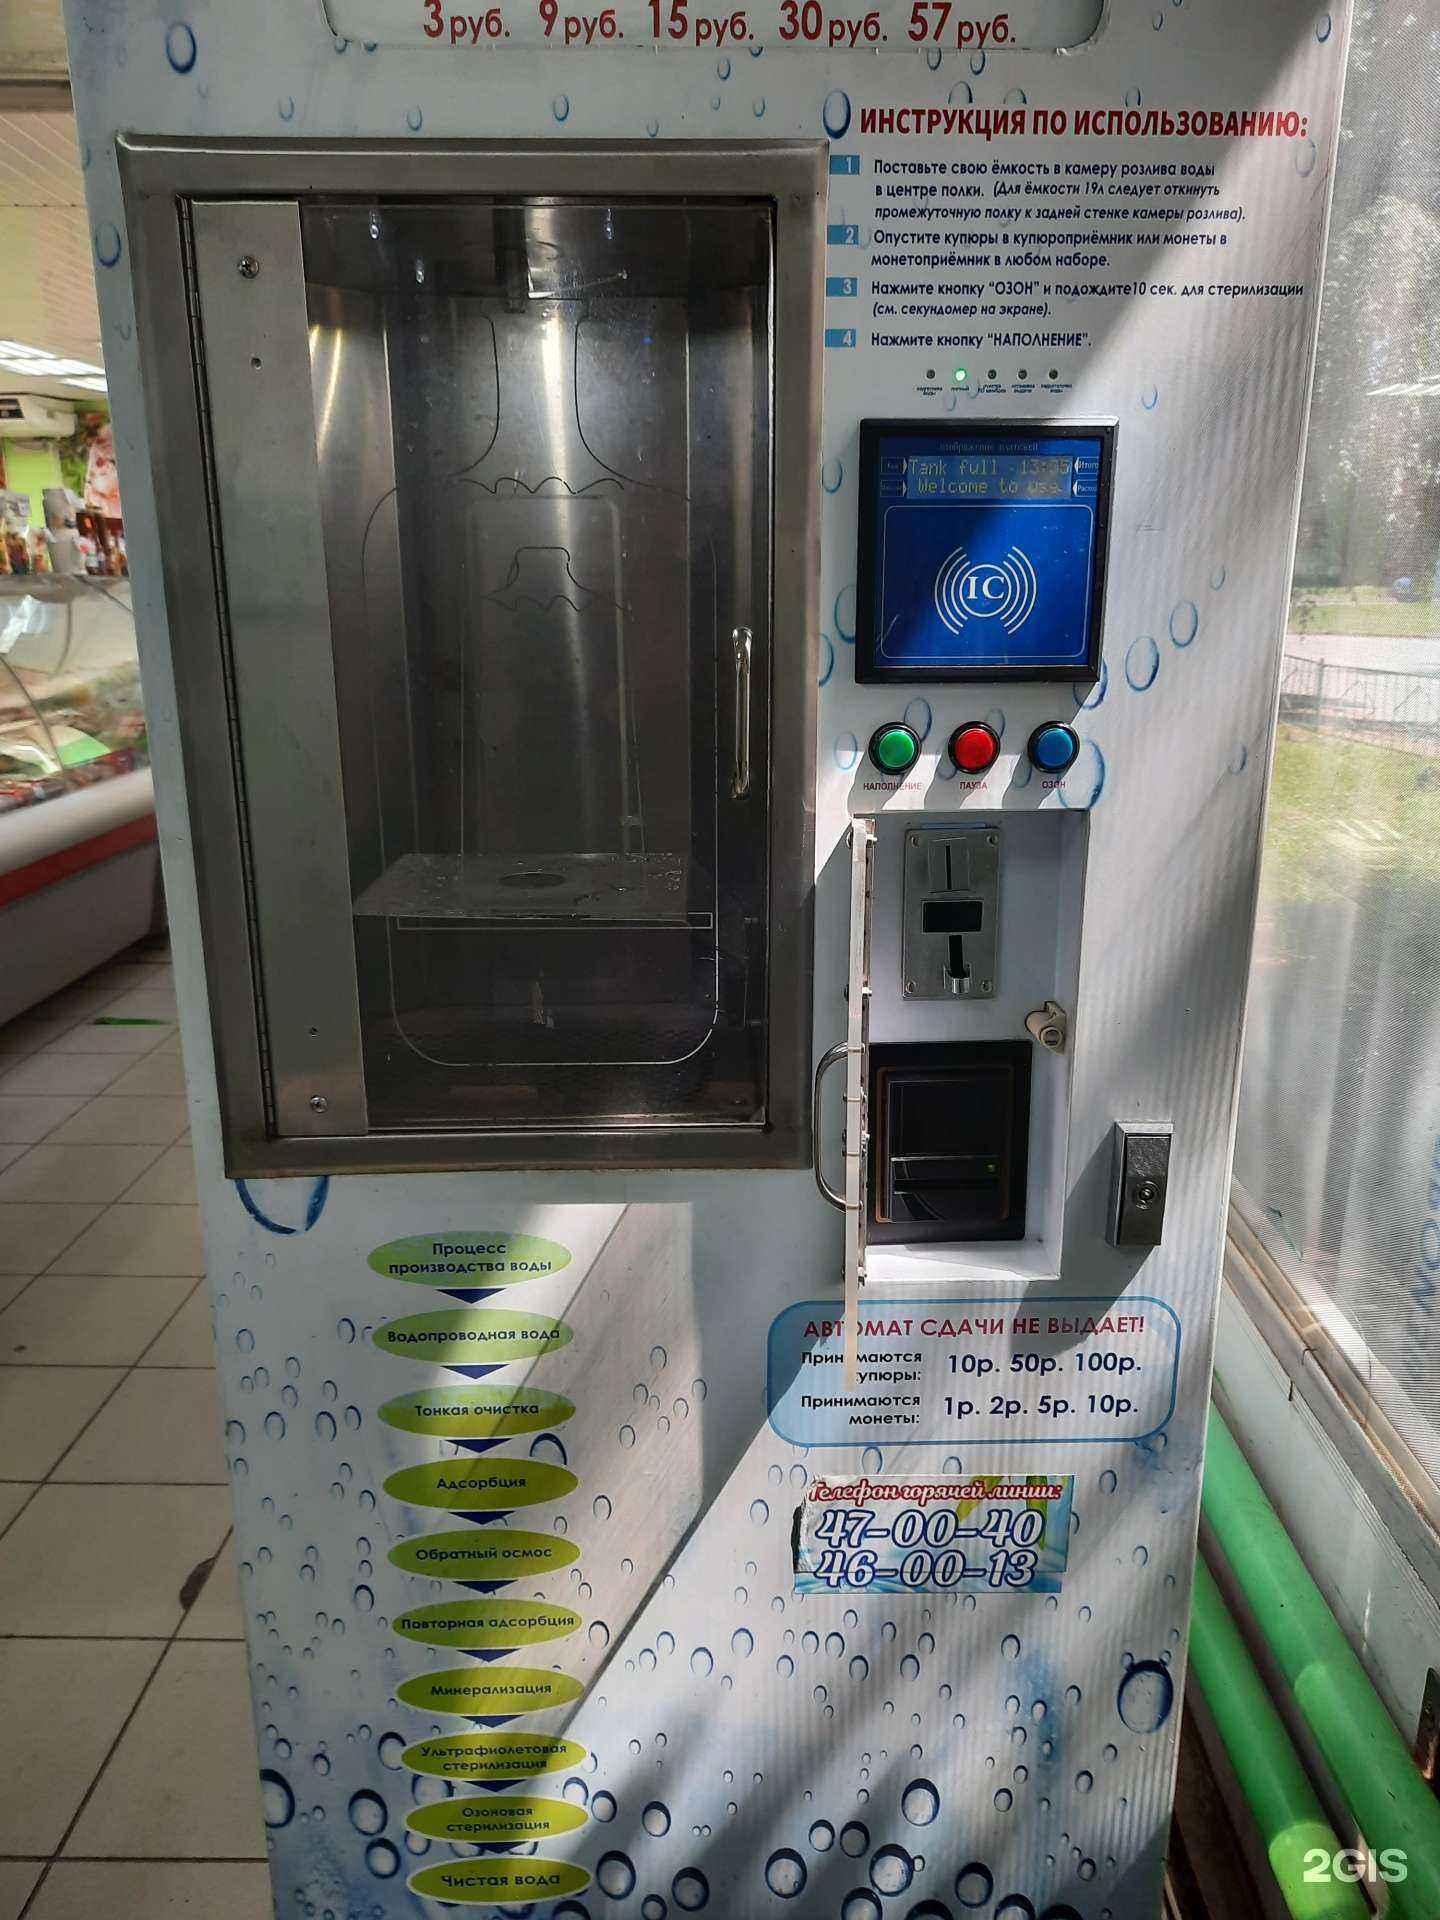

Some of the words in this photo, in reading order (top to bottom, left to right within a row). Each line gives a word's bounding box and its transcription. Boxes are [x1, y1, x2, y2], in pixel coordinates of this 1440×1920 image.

[424, 0, 444, 38] 3
[450, 8, 510, 44] руб.
[539, 0, 558, 37] 9
[565, 9, 624, 44] руб.
[649, 0, 688, 39] 15
[696, 11, 754, 47] руб.
[779, 0, 822, 41] 30
[829, 12, 887, 47] руб.
[907, 2, 951, 41] 57
[958, 14, 1016, 48] руб.
[860, 108, 1026, 140] ИНСТРУКЦИЯ
[1032, 110, 1067, 135] ПО
[1074, 110, 1308, 137] ИСПОЛЬЗОВАНИЮ:
[846, 156, 853, 173] 1
[874, 159, 947, 174] Поставьте
[951, 162, 987, 174] свою
[991, 160, 1049, 175] ёмкость
[1053, 164, 1060, 174] в
[1065, 163, 1116, 178] камеру
[1121, 164, 1176, 178] розлива
[1181, 164, 1215, 176] воды
[875, 185, 882, 196] в
[886, 184, 938, 199] центре
[941, 185, 984, 197] полки.
[993, 181, 1021, 197] (Для
[1025, 182, 1080, 195] ёмкости
[1084, 182, 1104, 194] 19л
[1108, 183, 1161, 198] следует
[1164, 184, 1219, 198] откинуть
[875, 207, 981, 220] промежуточную
[985, 208, 1021, 221] полку
[1025, 208, 1032, 218] к
[1035, 206, 1080, 220] задней
[1084, 208, 1129, 219] стенке
[1132, 208, 1184, 221] камеры
[1186, 207, 1245, 222] розлива).
[846, 227, 854, 244] 2
[874, 230, 940, 246] Опустите
[944, 232, 998, 246] купюры
[1003, 233, 1009, 244] в
[1013, 230, 1132, 247] купюроприёмник
[1137, 234, 1159, 245] или
[1164, 234, 1215, 245] монеты
[1220, 234, 1227, 245] в
[871, 252, 990, 268] монетоприёмник
[994, 255, 1001, 265] в
[1005, 253, 1051, 265] любом
[1055, 252, 1110, 268] наборе.
[843, 279, 851, 294] 3
[872, 281, 934, 295] Нажмите
[938, 284, 984, 298] кнопку
[1044, 284, 1051, 294] и
[1150, 284, 1177, 295] сек.
[1181, 285, 1204, 296] для
[1208, 284, 1303, 298] стерилизации
[872, 302, 897, 316] (см.
[901, 303, 977, 317] секундомер
[981, 305, 995, 315] на
[999, 303, 1051, 317] экране).
[843, 330, 852, 346] 4
[871, 333, 933, 346] Нажмите
[937, 335, 983, 349] кнопку
[909, 459, 947, 475] Tank
[960, 459, 997, 474] full
[918, 478, 987, 494] Welcome
[1000, 478, 1018, 494] to
[966, 576, 1005, 599] IC
[863, 782, 922, 791] НАПОЛНЕНИЕ
[959, 781, 987, 790] ПАУЗА
[1041, 781, 1066, 790] ОЗОН
[432, 1243, 506, 1257] Процесс
[389, 1261, 505, 1275] производства
[510, 1261, 551, 1272] воды
[920, 1318, 1003, 1338] СДАЧИ
[1013, 1317, 1040, 1334] НЕ
[1048, 1316, 1144, 1335] ВЫДАЕТ!
[388, 1329, 516, 1343] Водопроводная
[521, 1329, 560, 1340] вода
[802, 1351, 922, 1367] Принмаются
[948, 1353, 1000, 1377] 10р.
[1010, 1352, 1063, 1376] 50р.
[1075, 1352, 1141, 1375] 100р.
[857, 1370, 921, 1384] упюры:
[415, 1404, 468, 1417] Тонкая
[474, 1403, 539, 1415] очистка
[801, 1395, 920, 1410] Принимаются
[944, 1397, 980, 1419] 1р.
[990, 1396, 1028, 1418] 2р.
[1038, 1395, 1076, 1417] 5р.
[1088, 1394, 1138, 1417] 10р.
[848, 1413, 920, 1425] монеты:
[437, 1477, 526, 1491] Адсорбция
[808, 1478, 898, 1507] Телефон
[901, 1481, 985, 1507] горячей
[988, 1483, 1062, 1500] линии:
[416, 1546, 498, 1562] Обратный
[502, 1548, 552, 1559] осмос
[402, 1618, 484, 1631] Повторная
[489, 1615, 574, 1629] адсорбция
[430, 1684, 552, 1697] Минерализация
[421, 1744, 567, 1758] Ультрафиолетовая
[443, 1760, 547, 1773] стерилизация
[462, 1807, 533, 1818] Озоновая
[447, 1821, 549, 1834] стерилизация
[441, 1874, 509, 1887] Чистая
[515, 1874, 560, 1887] вода
